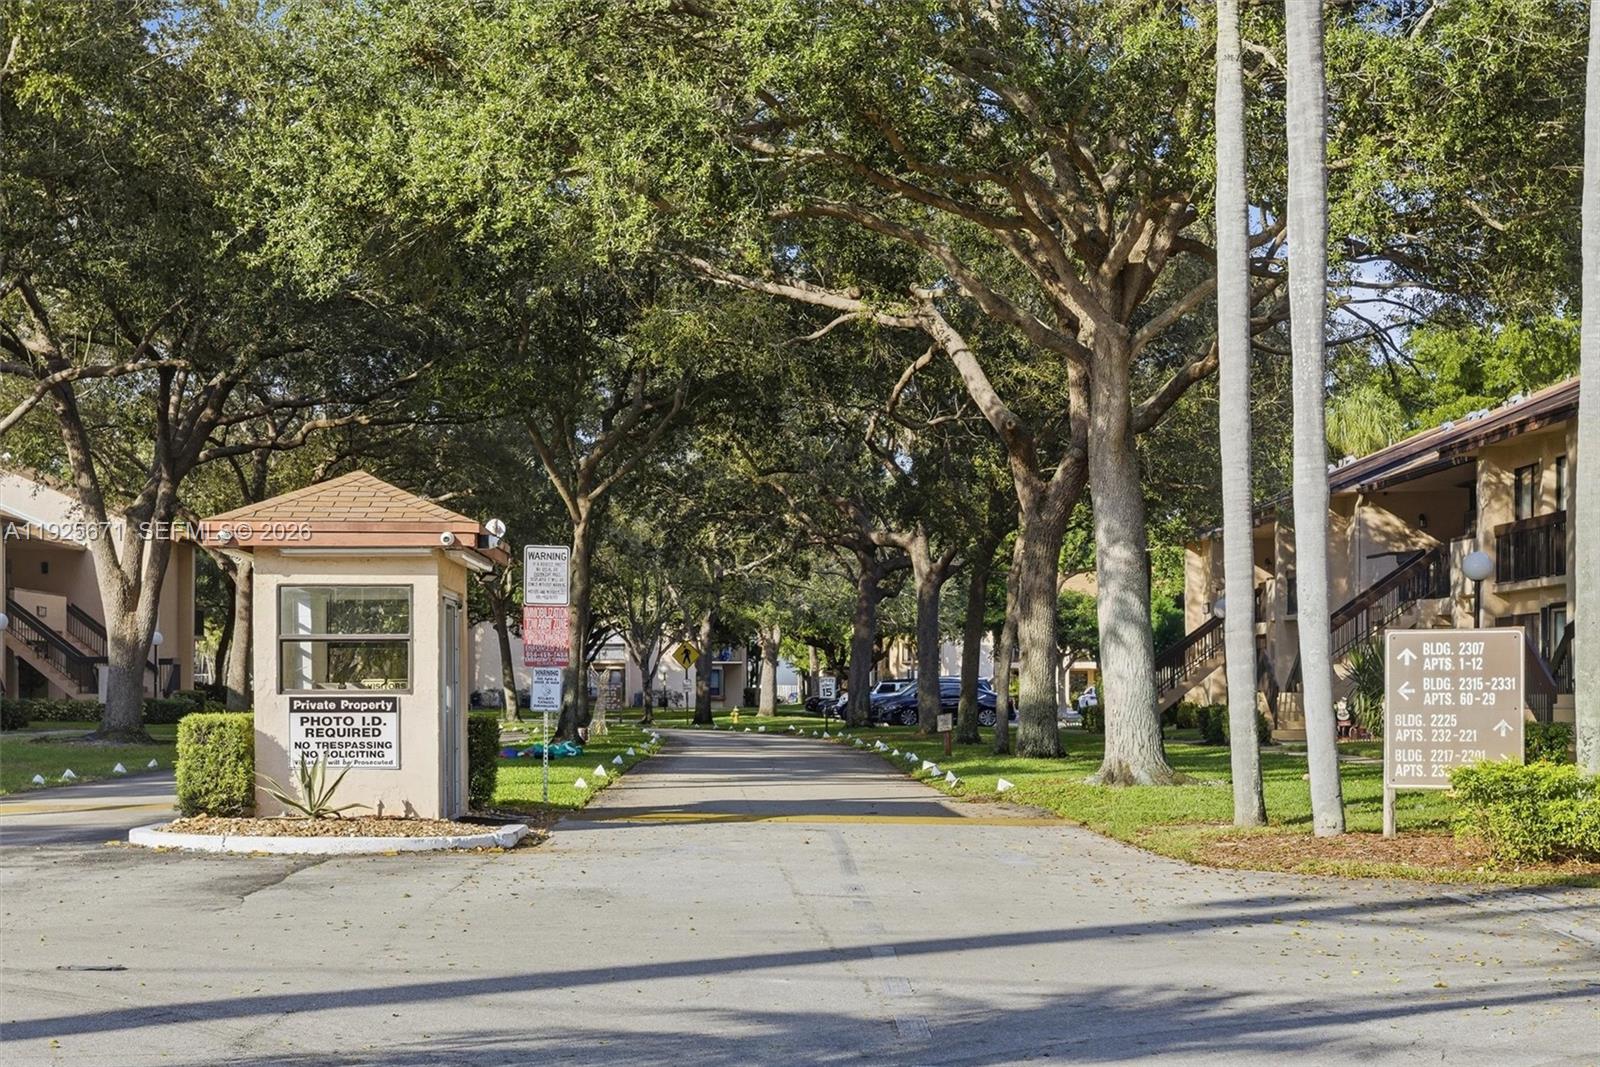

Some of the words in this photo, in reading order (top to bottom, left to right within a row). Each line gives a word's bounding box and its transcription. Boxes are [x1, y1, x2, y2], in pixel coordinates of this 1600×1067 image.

[528, 551, 567, 561] WARNING
[1423, 642, 1454, 656] BLDG.
[1459, 642, 1485, 656] 2307
[1423, 657, 1455, 671] APTS.
[1459, 657, 1483, 671] 1-12
[1423, 677, 1454, 691] BLDG.
[822, 688, 833, 697] 15
[1423, 692, 1455, 706] APTS.
[293, 700, 336, 710] Private
[341, 700, 393, 712] Property
[300, 716, 355, 727] PHOTO
[362, 716, 387, 727] I.D.
[1395, 714, 1426, 727] BLDG.
[1430, 714, 1457, 727] 2225
[305, 727, 382, 738] REQUIRED
[1395, 729, 1427, 742] APTS.
[294, 741, 311, 750] NO
[315, 741, 393, 750] TRESPASSING
[1395, 749, 1426, 762] BLDG.
[1395, 764, 1427, 777] APTS.
